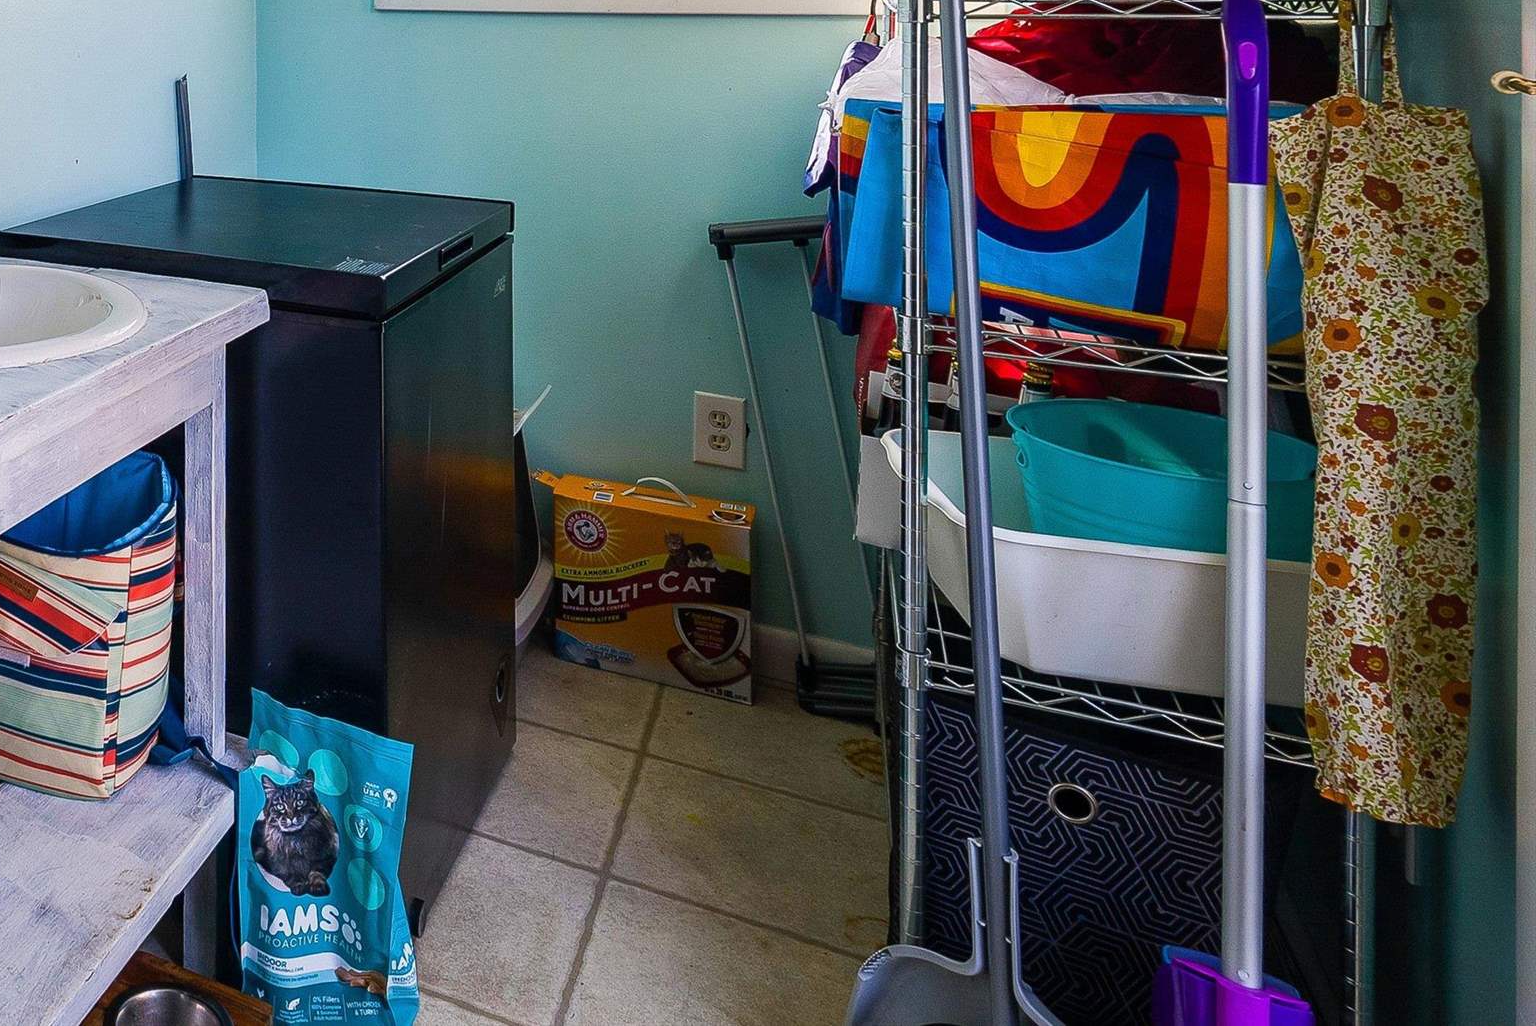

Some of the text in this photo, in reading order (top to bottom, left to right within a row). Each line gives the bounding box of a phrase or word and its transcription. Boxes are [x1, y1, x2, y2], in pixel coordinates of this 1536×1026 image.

[363, 787, 381, 799] USA
[260, 903, 340, 937] IAMS
[258, 932, 362, 964] PROACTIVE HEALTH
